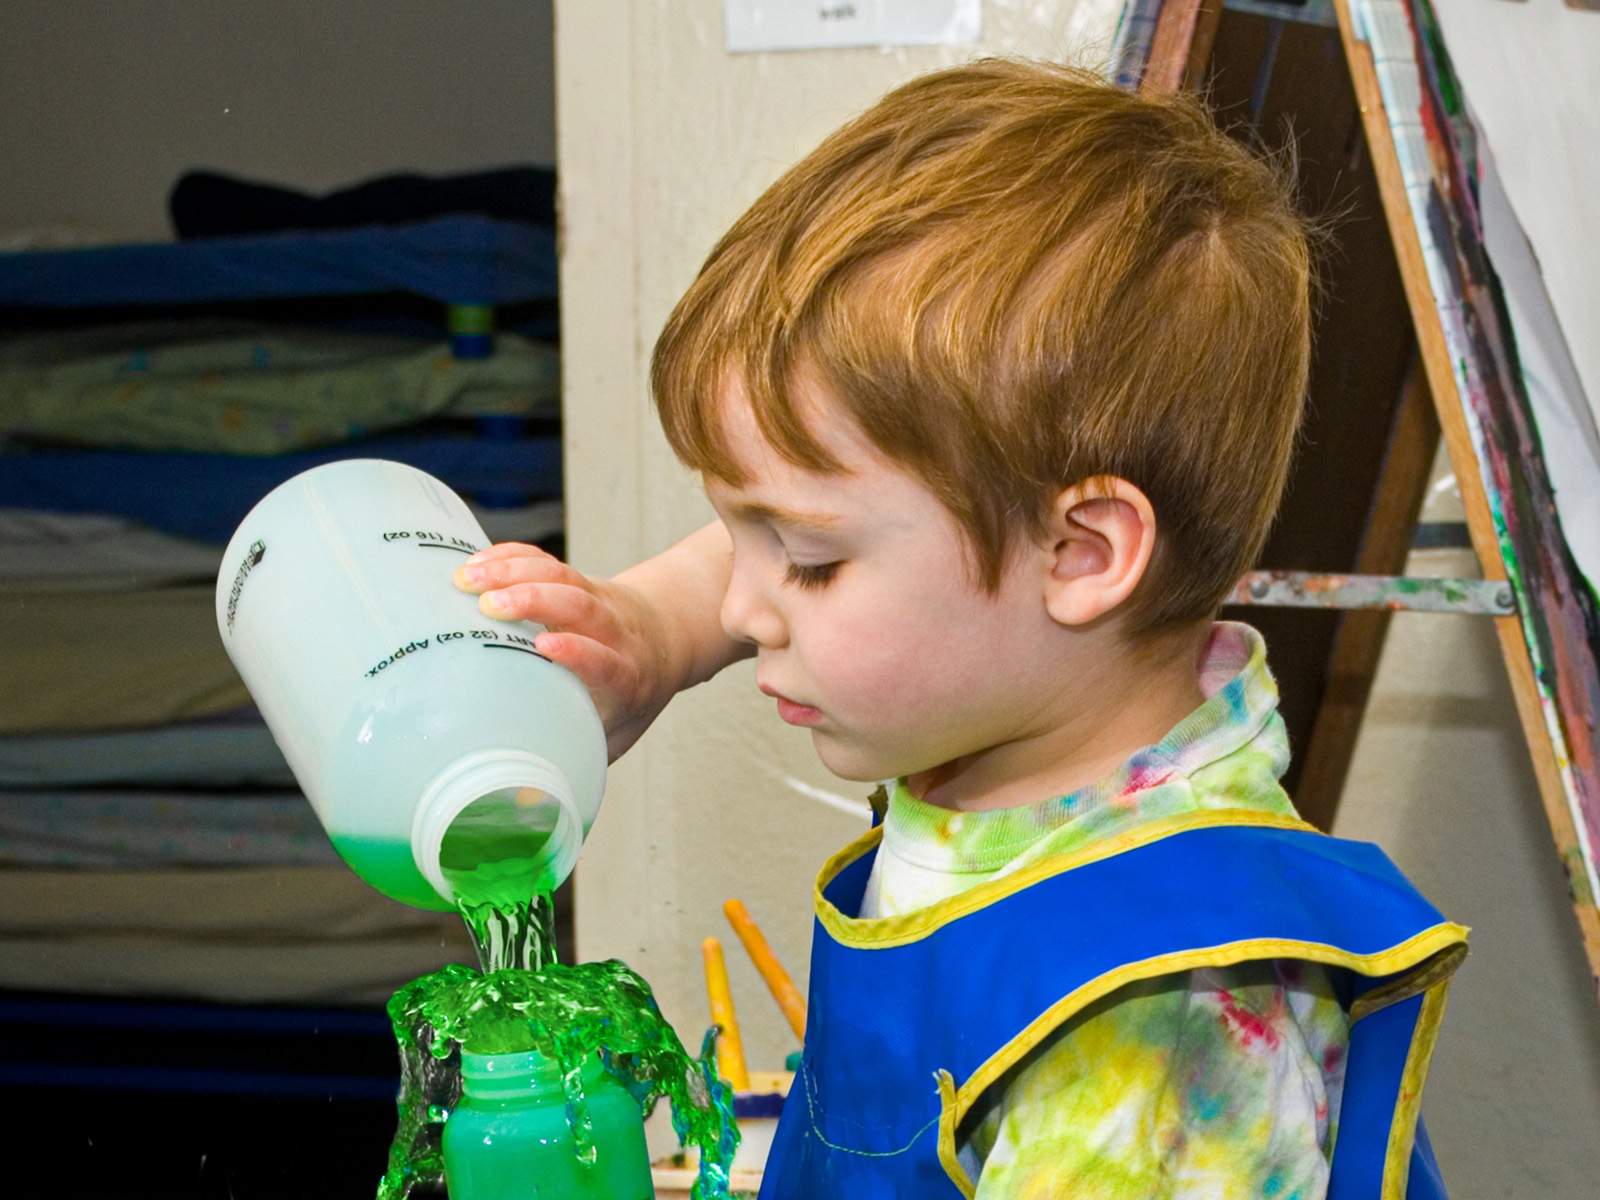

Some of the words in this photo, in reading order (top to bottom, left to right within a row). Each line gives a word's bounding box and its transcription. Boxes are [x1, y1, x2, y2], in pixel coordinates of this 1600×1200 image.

[383, 531, 410, 542] oz)
[415, 531, 443, 542] (16
[451, 537, 480, 552] INT
[436, 631, 464, 644] oz)
[469, 629, 499, 640] (32
[364, 638, 429, 678] Approx.
